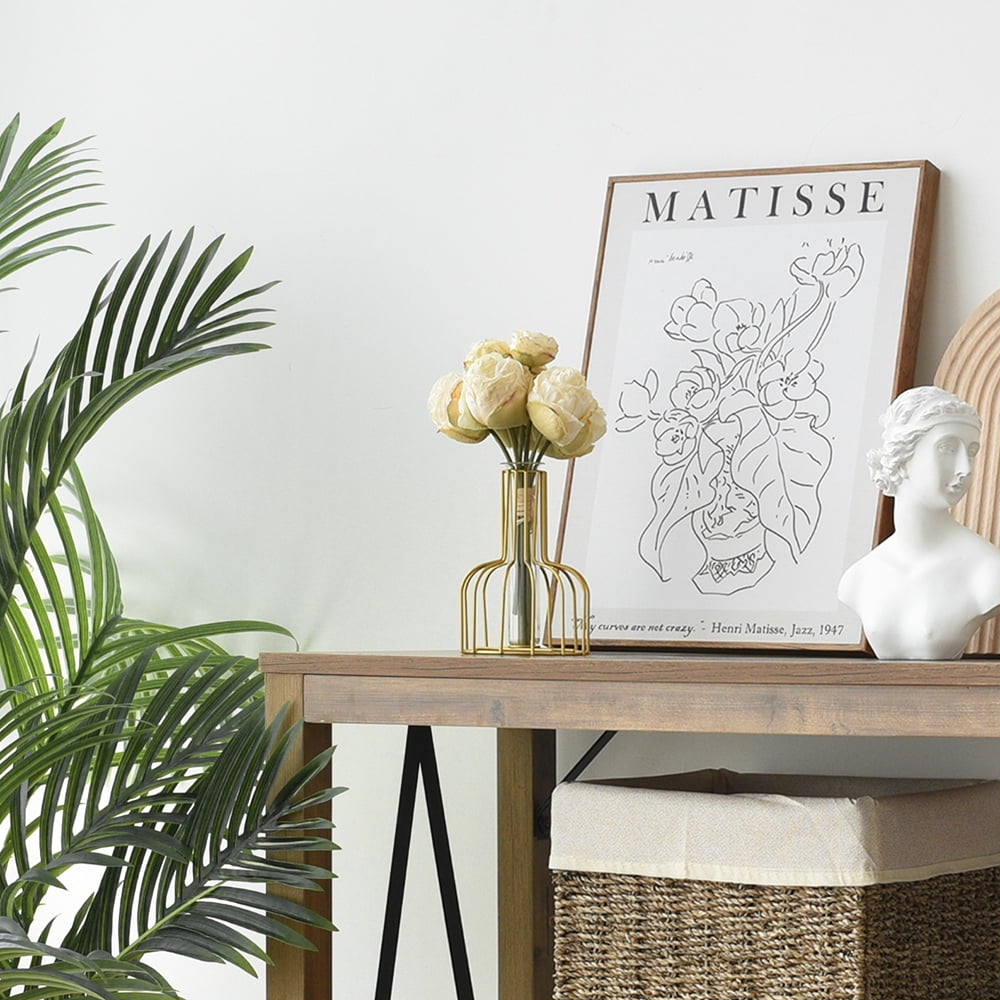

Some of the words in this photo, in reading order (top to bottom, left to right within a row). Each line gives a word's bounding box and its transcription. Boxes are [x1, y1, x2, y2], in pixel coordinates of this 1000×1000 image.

[642, 181, 884, 223] MATISSE
[598, 623, 629, 632] curves
[630, 624, 646, 632] are
[648, 623, 663, 632] not
[711, 622, 742, 634] Henri
[745, 623, 787, 637] Matisse,
[790, 623, 816, 638] Jazz,
[819, 624, 844, 636] 1947
